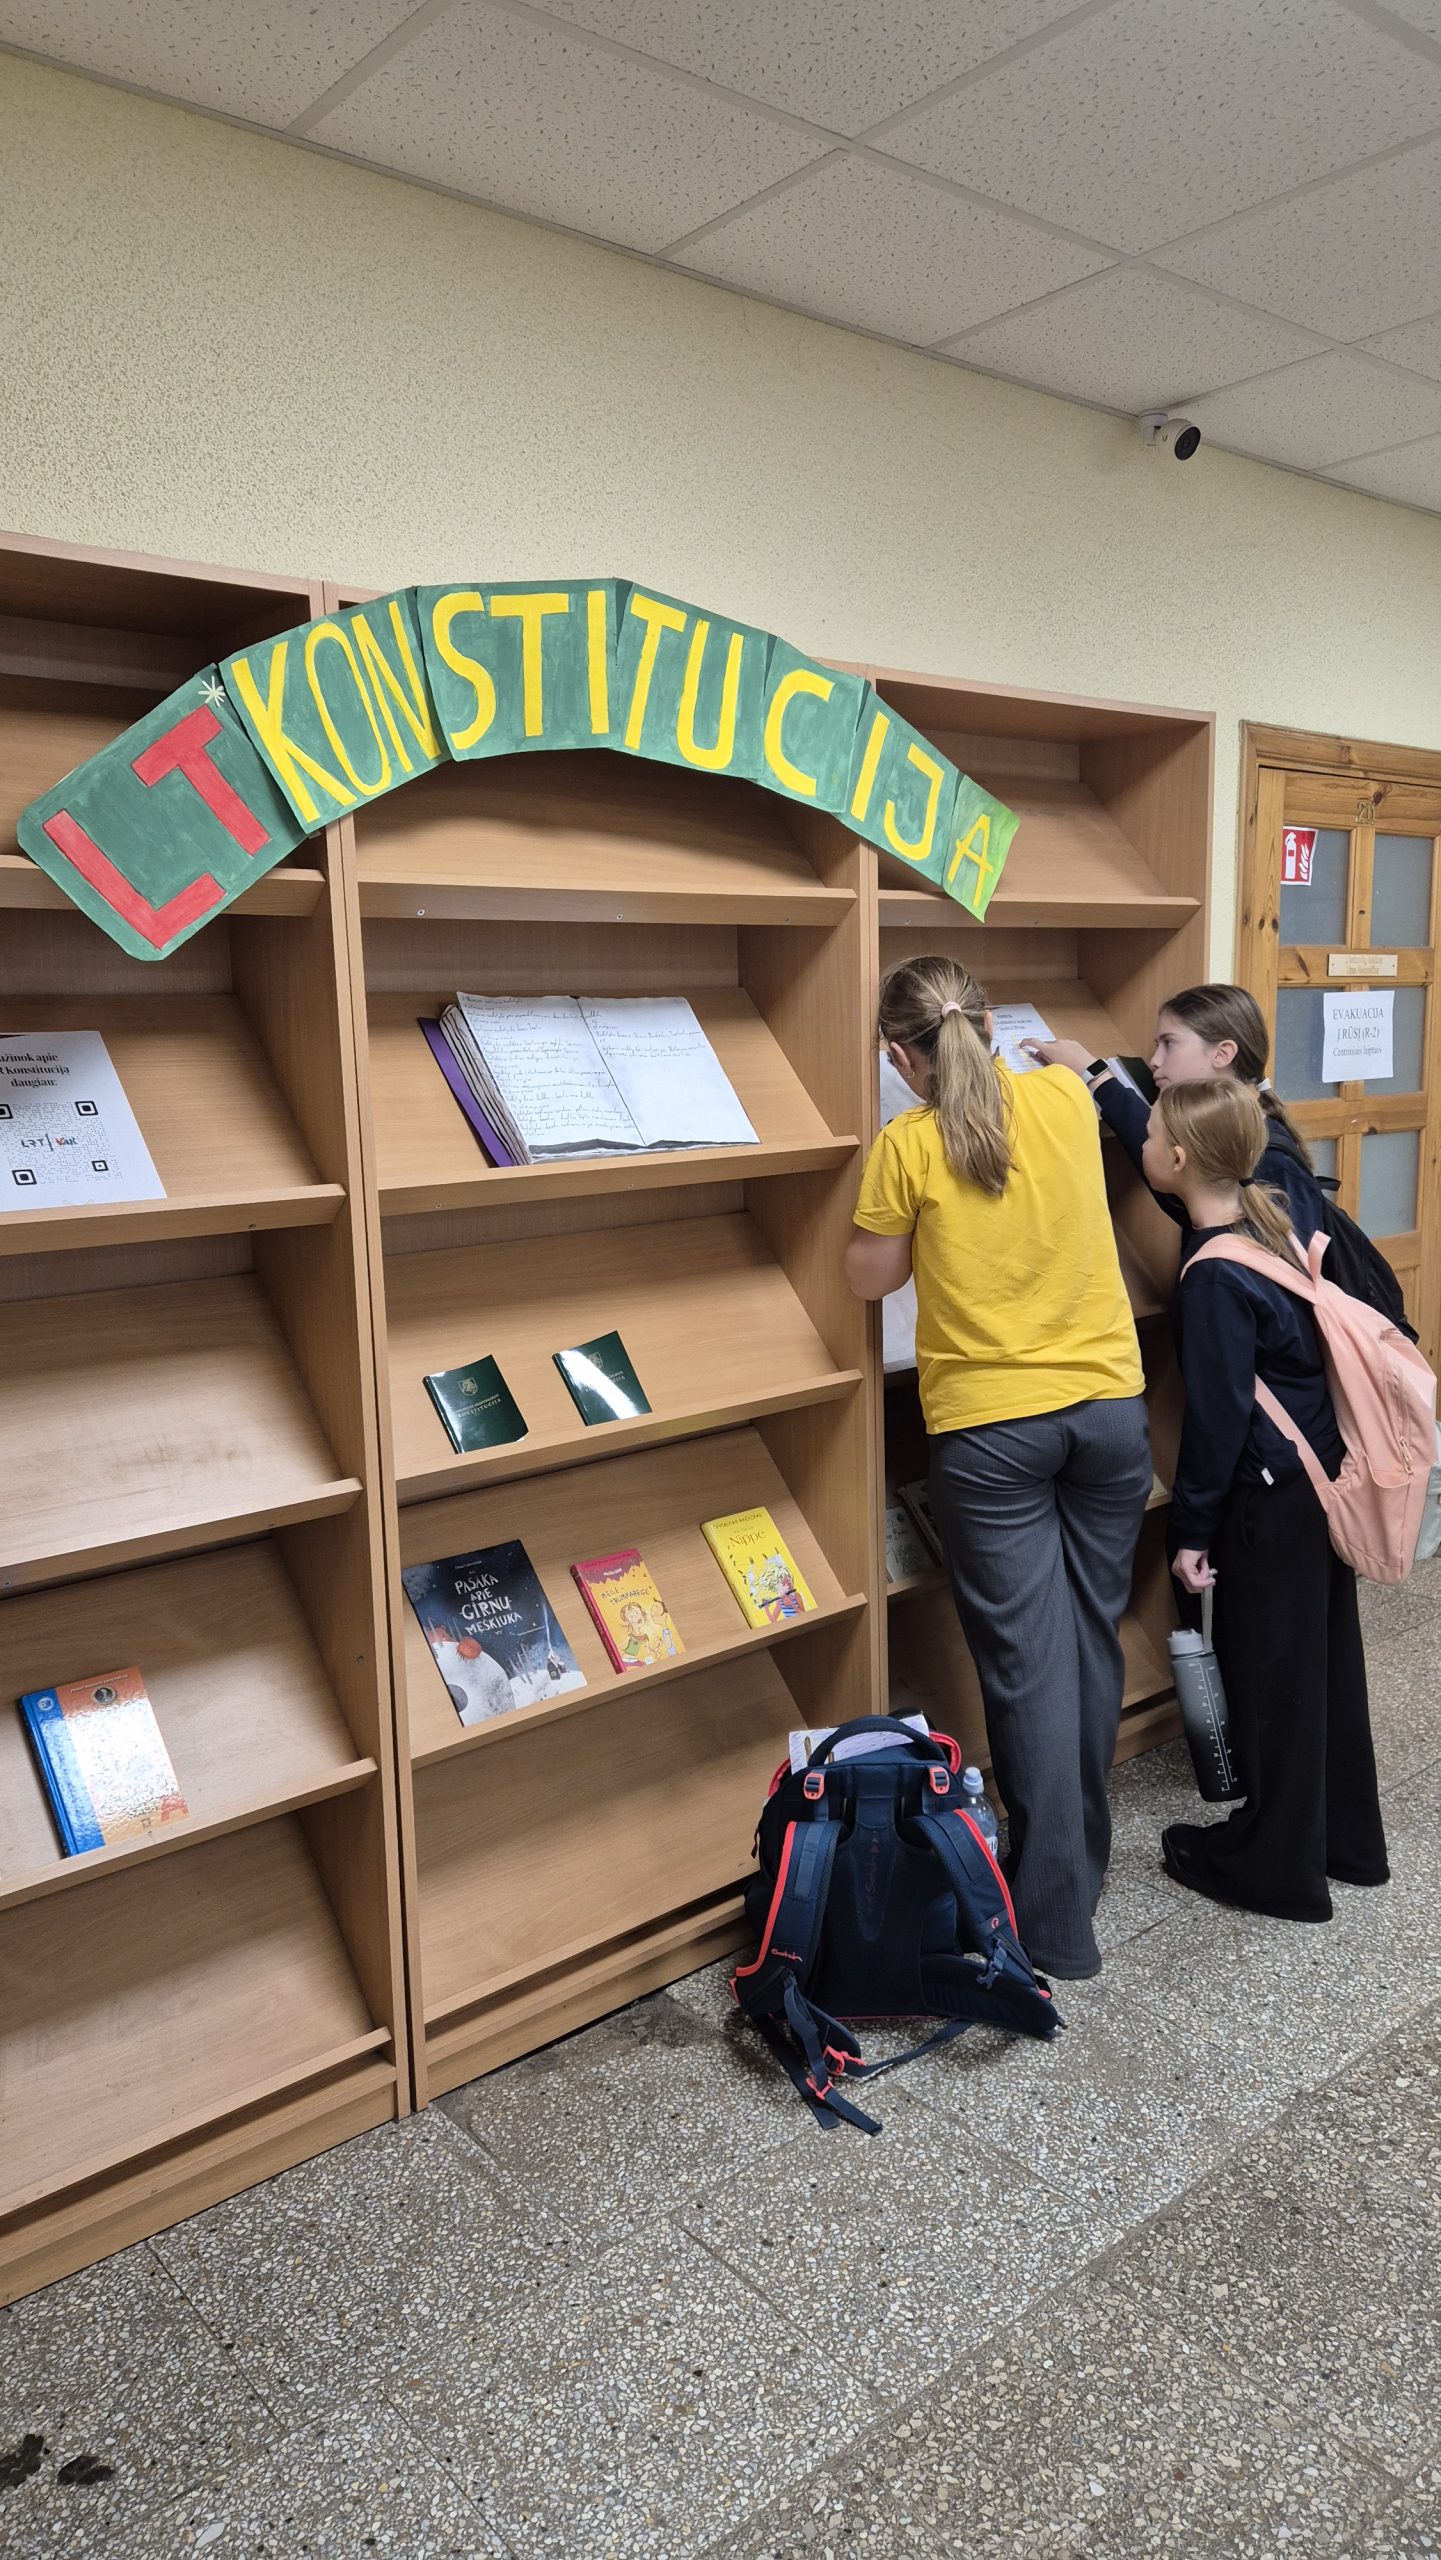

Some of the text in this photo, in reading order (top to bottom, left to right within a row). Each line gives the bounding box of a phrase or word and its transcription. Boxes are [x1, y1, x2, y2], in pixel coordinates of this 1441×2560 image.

[43, 590, 995, 950] LT KONSTITUCIJA
[1333, 1007, 1385, 1020] EVAKUACIJA
[1361, 1026, 1380, 1040] (R-2)
[36, 1052, 59, 1063] apie
[470, 1587, 494, 1602] APIE
